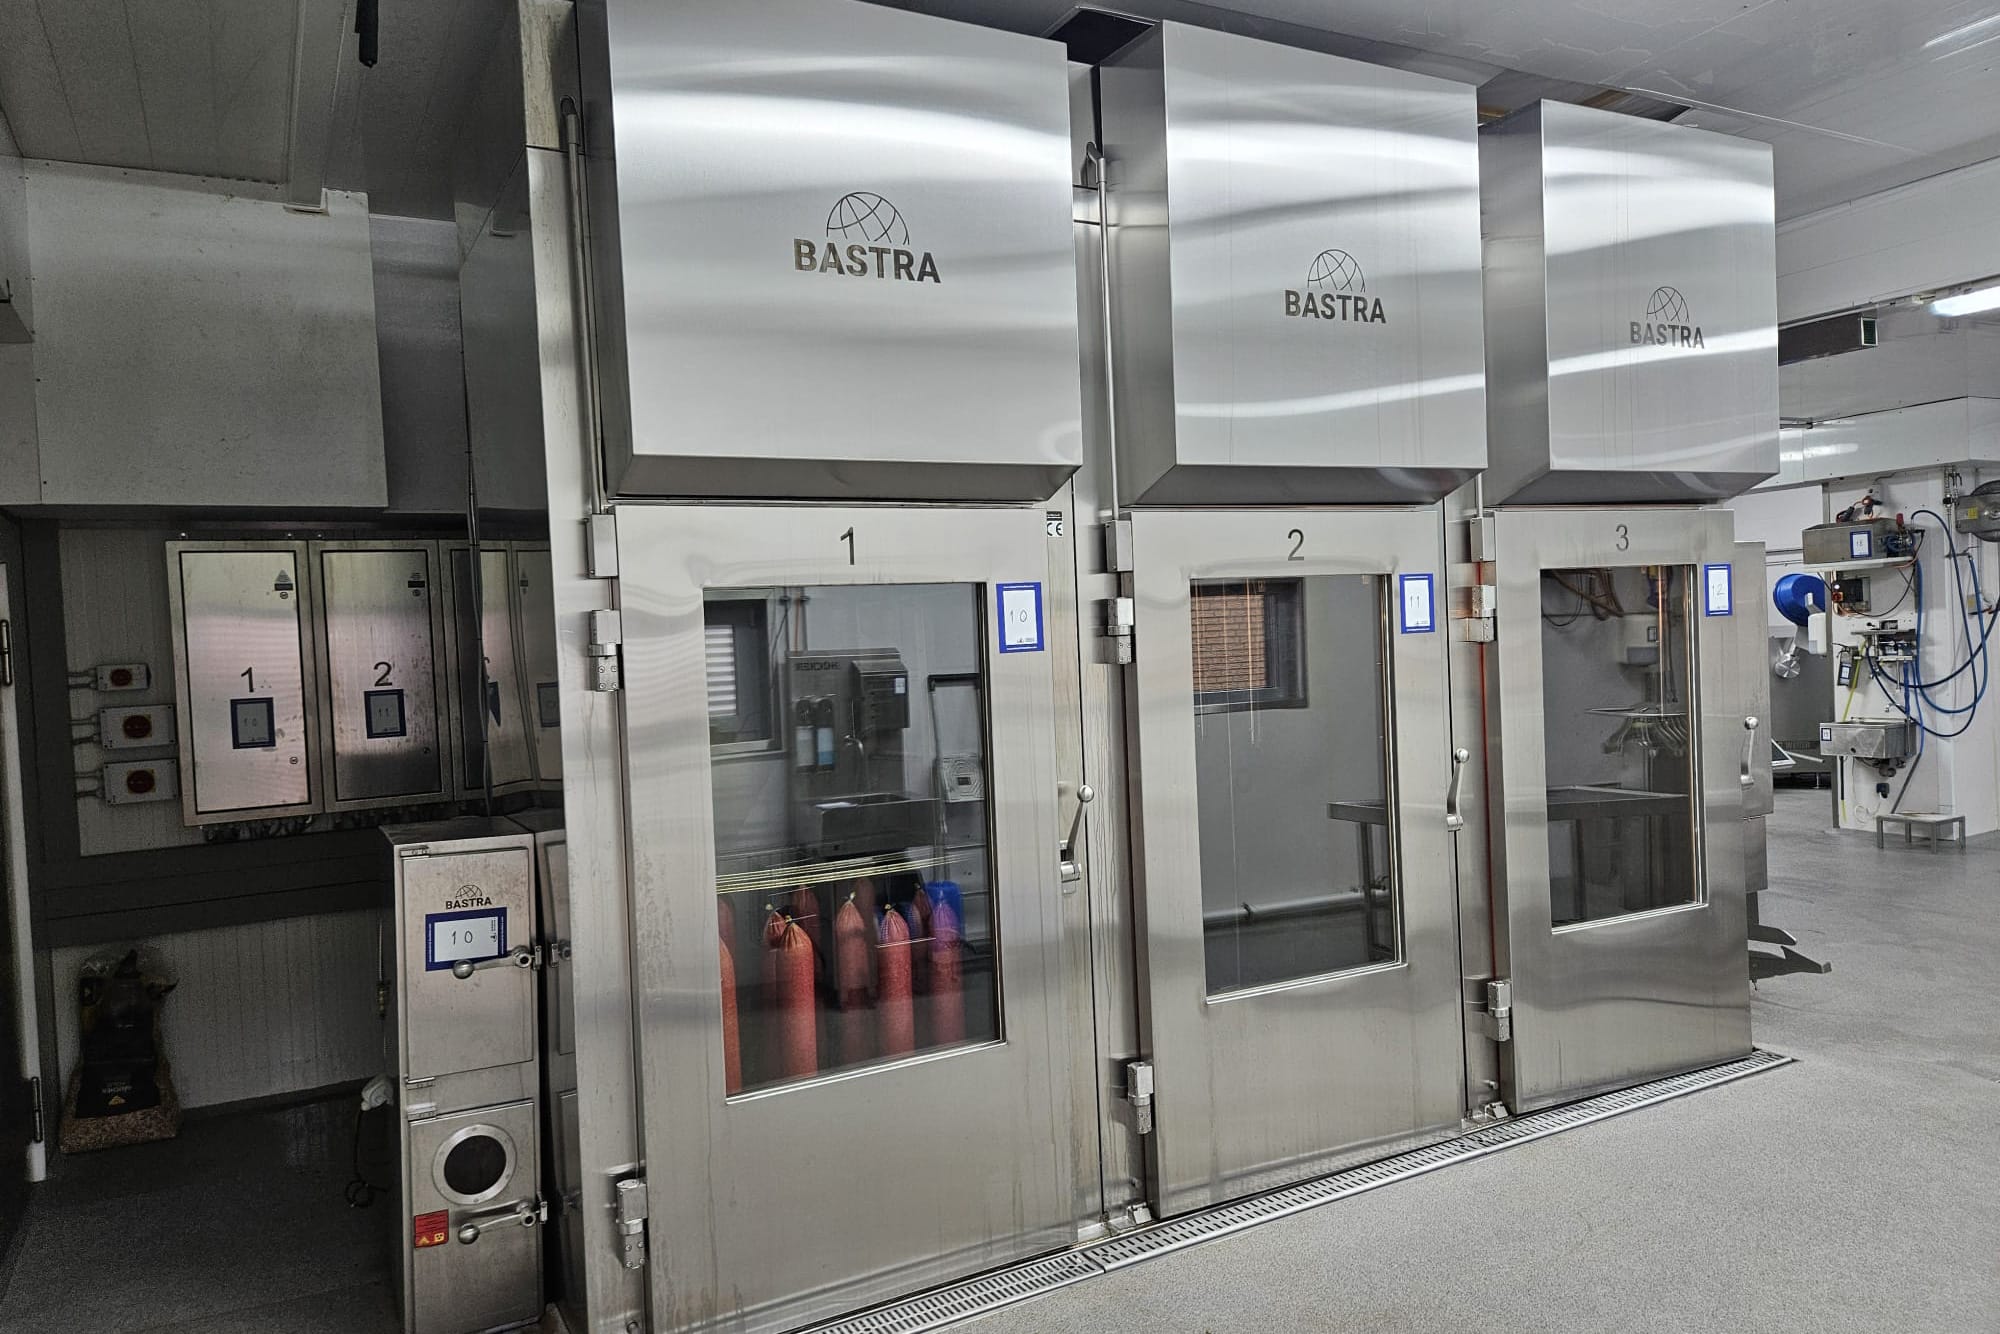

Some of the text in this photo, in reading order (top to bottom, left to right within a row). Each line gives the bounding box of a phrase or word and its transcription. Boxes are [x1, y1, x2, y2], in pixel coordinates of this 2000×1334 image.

[793, 238, 941, 283] BASTRA
[1284, 289, 1387, 324] BASTRA
[1630, 321, 1705, 349] BASTRA
[840, 526, 855, 566] 1
[1287, 528, 1305, 561] 2
[1615, 523, 1629, 552] 3
[1010, 609, 1028, 624] 10
[241, 666, 255, 693] 1
[373, 661, 393, 687] 2
[445, 896, 493, 910] BASTRA
[451, 930, 474, 945] 10
